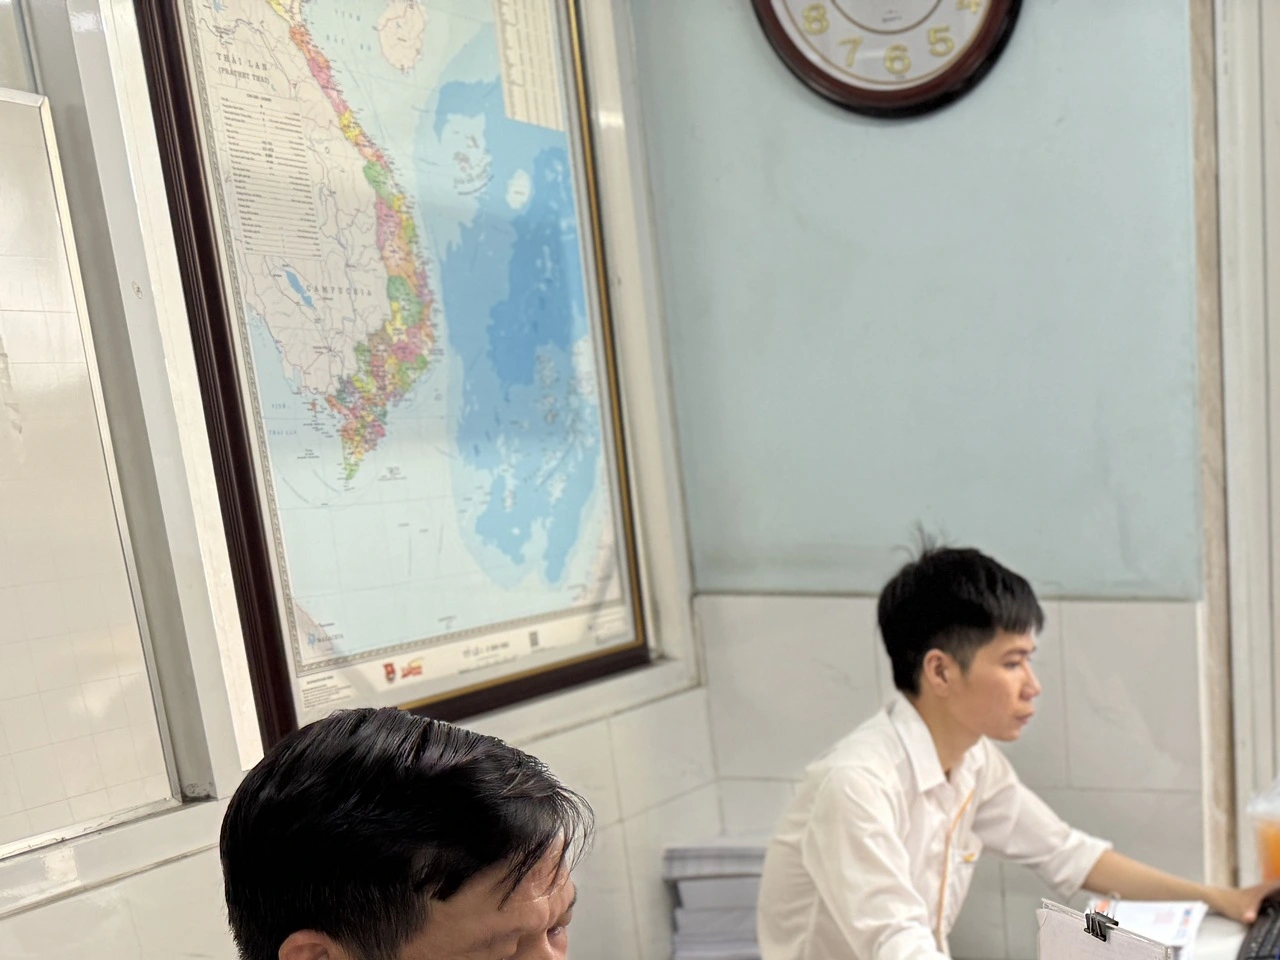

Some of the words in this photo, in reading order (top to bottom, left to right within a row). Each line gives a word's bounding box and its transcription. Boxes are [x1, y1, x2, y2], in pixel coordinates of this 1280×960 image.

[802, 3, 829, 35] 8
[838, 35, 863, 67] 7
[927, 25, 955, 57] 5
[883, 44, 911, 75] 6
